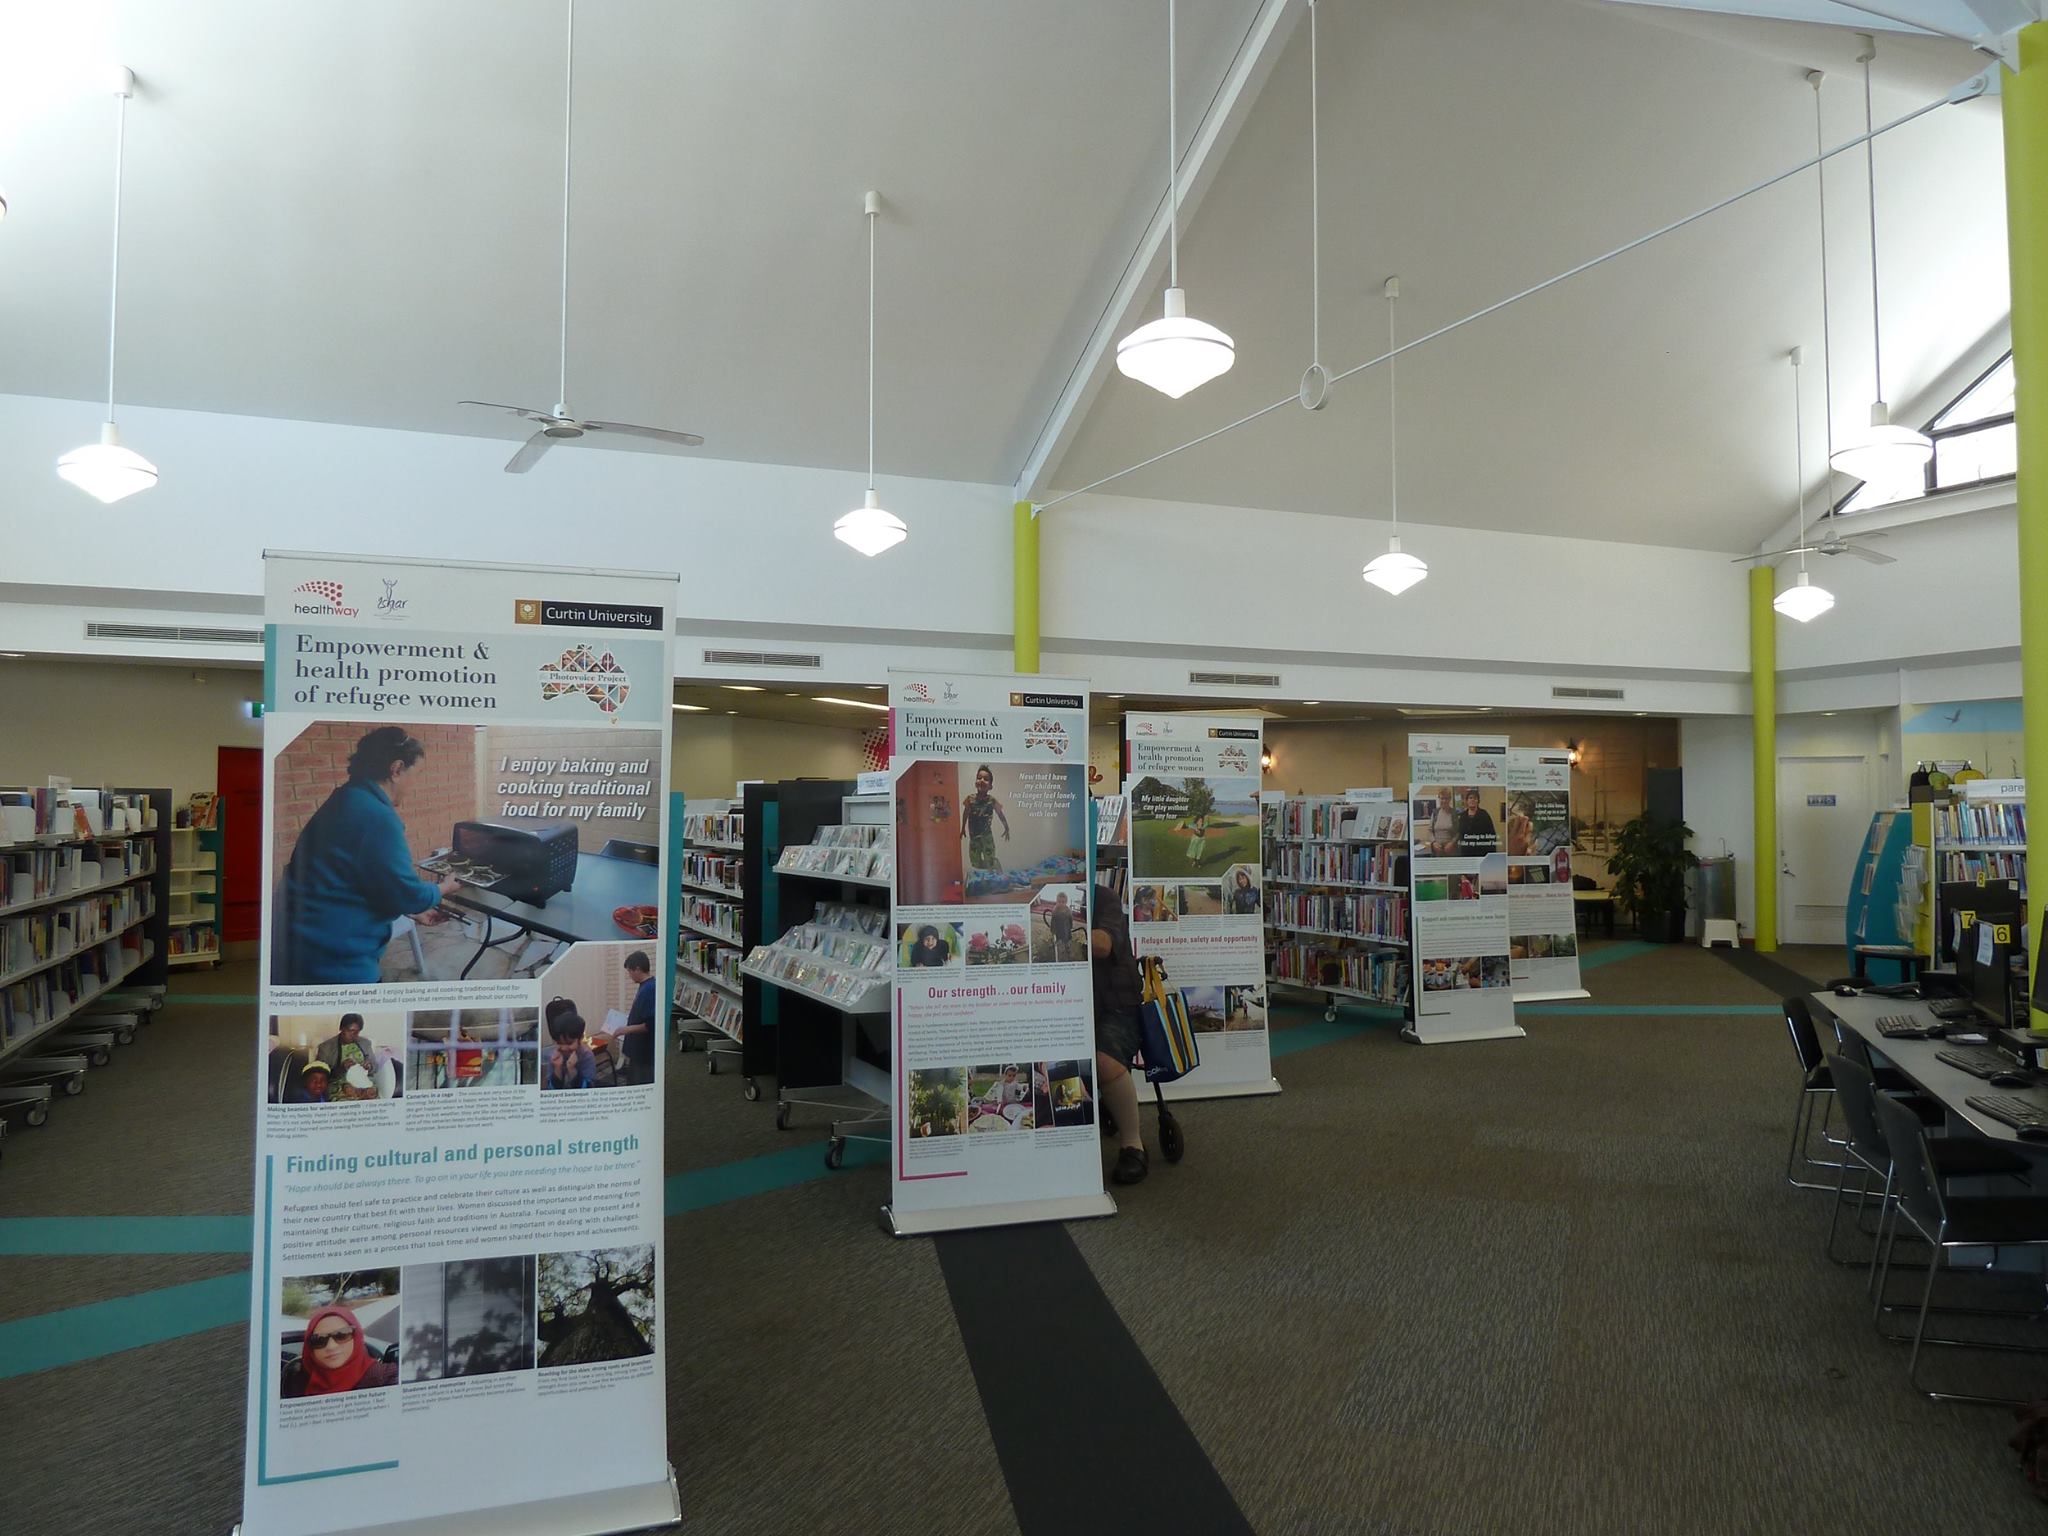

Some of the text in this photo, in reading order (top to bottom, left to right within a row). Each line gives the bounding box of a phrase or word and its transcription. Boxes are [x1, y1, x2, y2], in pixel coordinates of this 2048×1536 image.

[295, 604, 359, 618] healthway
[547, 608, 652, 626] Curtin University
[296, 635, 489, 665] Empowerment &
[295, 660, 496, 688] health promotion
[550, 673, 626, 683] Photovoice Project
[295, 687, 496, 711] of refugee women
[1025, 696, 1078, 706] Curtin University
[906, 713, 999, 727] Empowerment &
[906, 728, 1003, 741] health promotion
[906, 742, 1003, 754] of refugee women
[1138, 744, 1192, 753] Empowerment
[1164, 754, 1204, 763] promotion
[500, 757, 649, 776] I enjoy baking and
[1148, 763, 1176, 772] refugee
[498, 780, 651, 797] cooking traditional
[1022, 792, 1043, 800] longer
[1141, 795, 1151, 803] My
[502, 803, 646, 820] food for my family
[1155, 804, 1168, 812] play
[1979, 873, 1984, 885] 8
[1964, 913, 1974, 926] 7
[1142, 936, 1164, 945] Refuge
[1190, 936, 1210, 944] safety
[1224, 936, 1258, 944] opportunity
[1996, 926, 2008, 942] 6
[928, 987, 948, 998] Our
[1032, 982, 1066, 996] family
[287, 1134, 638, 1173] Finding cultural and personal strength
[313, 1180, 342, 1191] should
[343, 1181, 354, 1189] be
[356, 1178, 385, 1188] always
[459, 1172, 478, 1181] your
[479, 1169, 491, 1180] life
[493, 1170, 508, 1179] you
[558, 1164, 571, 1174] the
[284, 1204, 318, 1212] Refugees
[320, 1202, 346, 1210] should
[348, 1200, 363, 1208] feel
[364, 1198, 380, 1206] safe
[392, 1195, 422, 1206] practice
[440, 1192, 473, 1200] celebrate
[476, 1189, 493, 1197] their
[495, 1187, 520, 1195] culture
[532, 1184, 546, 1192] well
[558, 1183, 596, 1192] distinguish
[610, 1180, 632, 1188] norms
[322, 1214, 352, 1222] country
[354, 1211, 369, 1219] that
[371, 1210, 387, 1218] best
[400, 1206, 416, 1214] with
[417, 1206, 434, 1214] their
[458, 1202, 486, 1210] Women
[487, 1199, 521, 1208] discussed
[536, 1196, 576, 1206] importance
[578, 1194, 592, 1202] and
[594, 1192, 623, 1202] meaning
[624, 1190, 640, 1198] from
